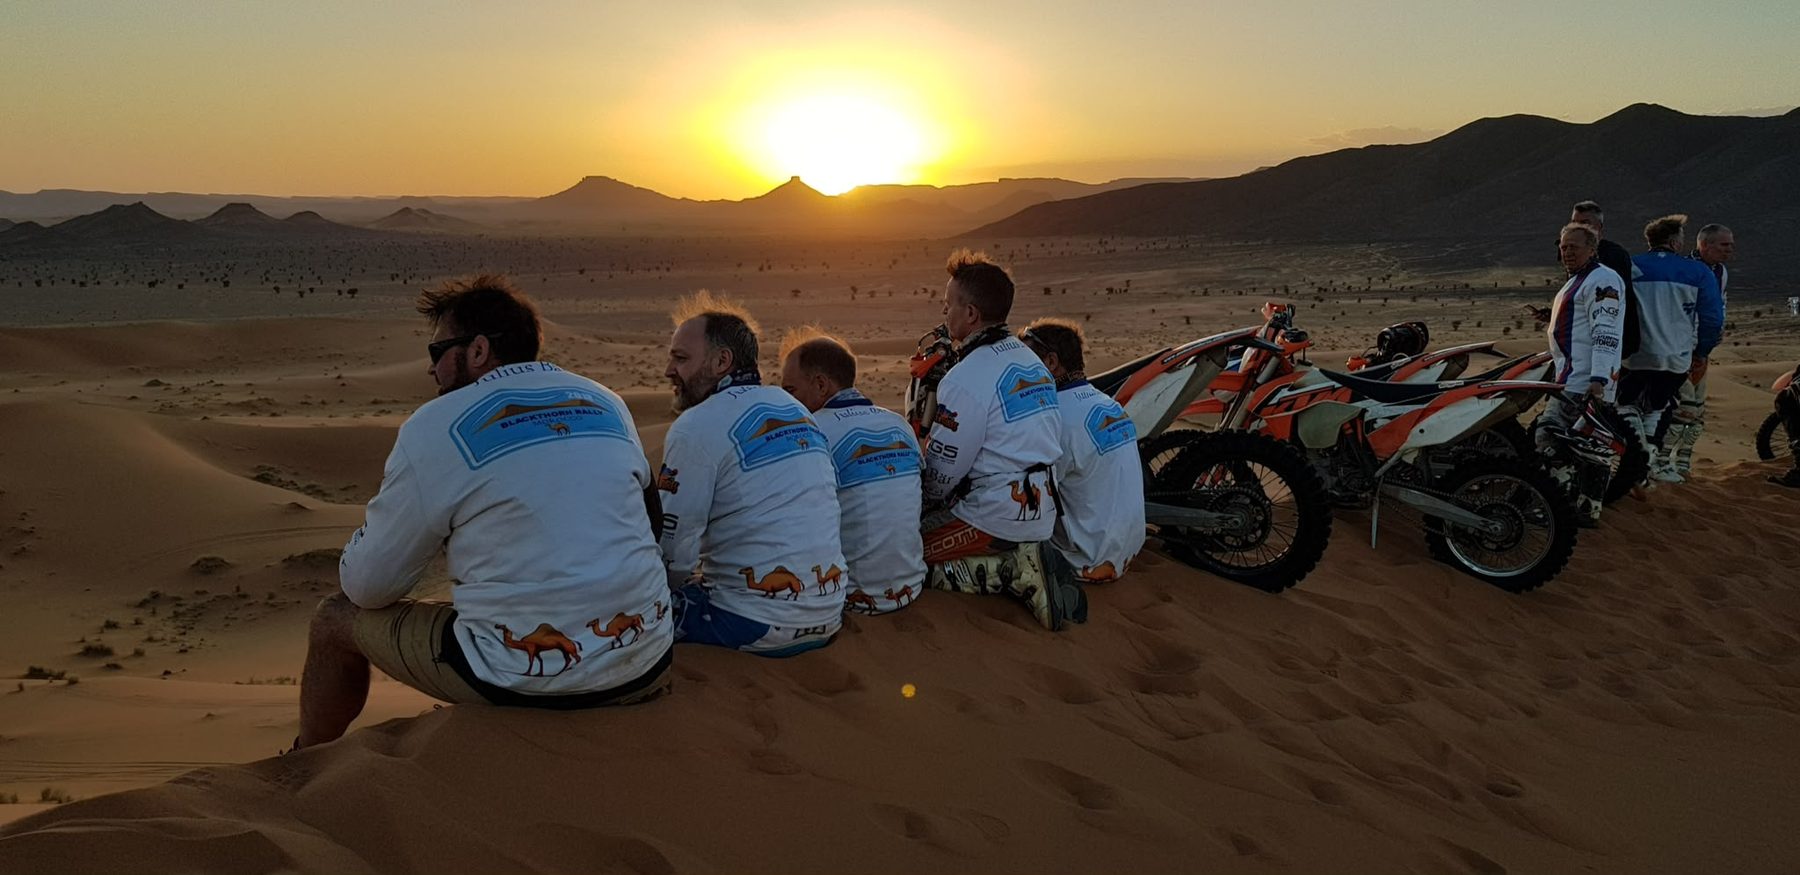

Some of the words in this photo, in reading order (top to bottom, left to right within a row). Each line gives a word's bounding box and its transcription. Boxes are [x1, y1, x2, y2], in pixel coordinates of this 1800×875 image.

[990, 340, 1020, 356] Julius
[500, 410, 572, 429] BLACKTHORN
[765, 427, 808, 442] BLACKTHORN
[857, 453, 897, 465] BLACKTHORN
[930, 467, 954, 484] Bär
[924, 526, 978, 557] SCOTT
